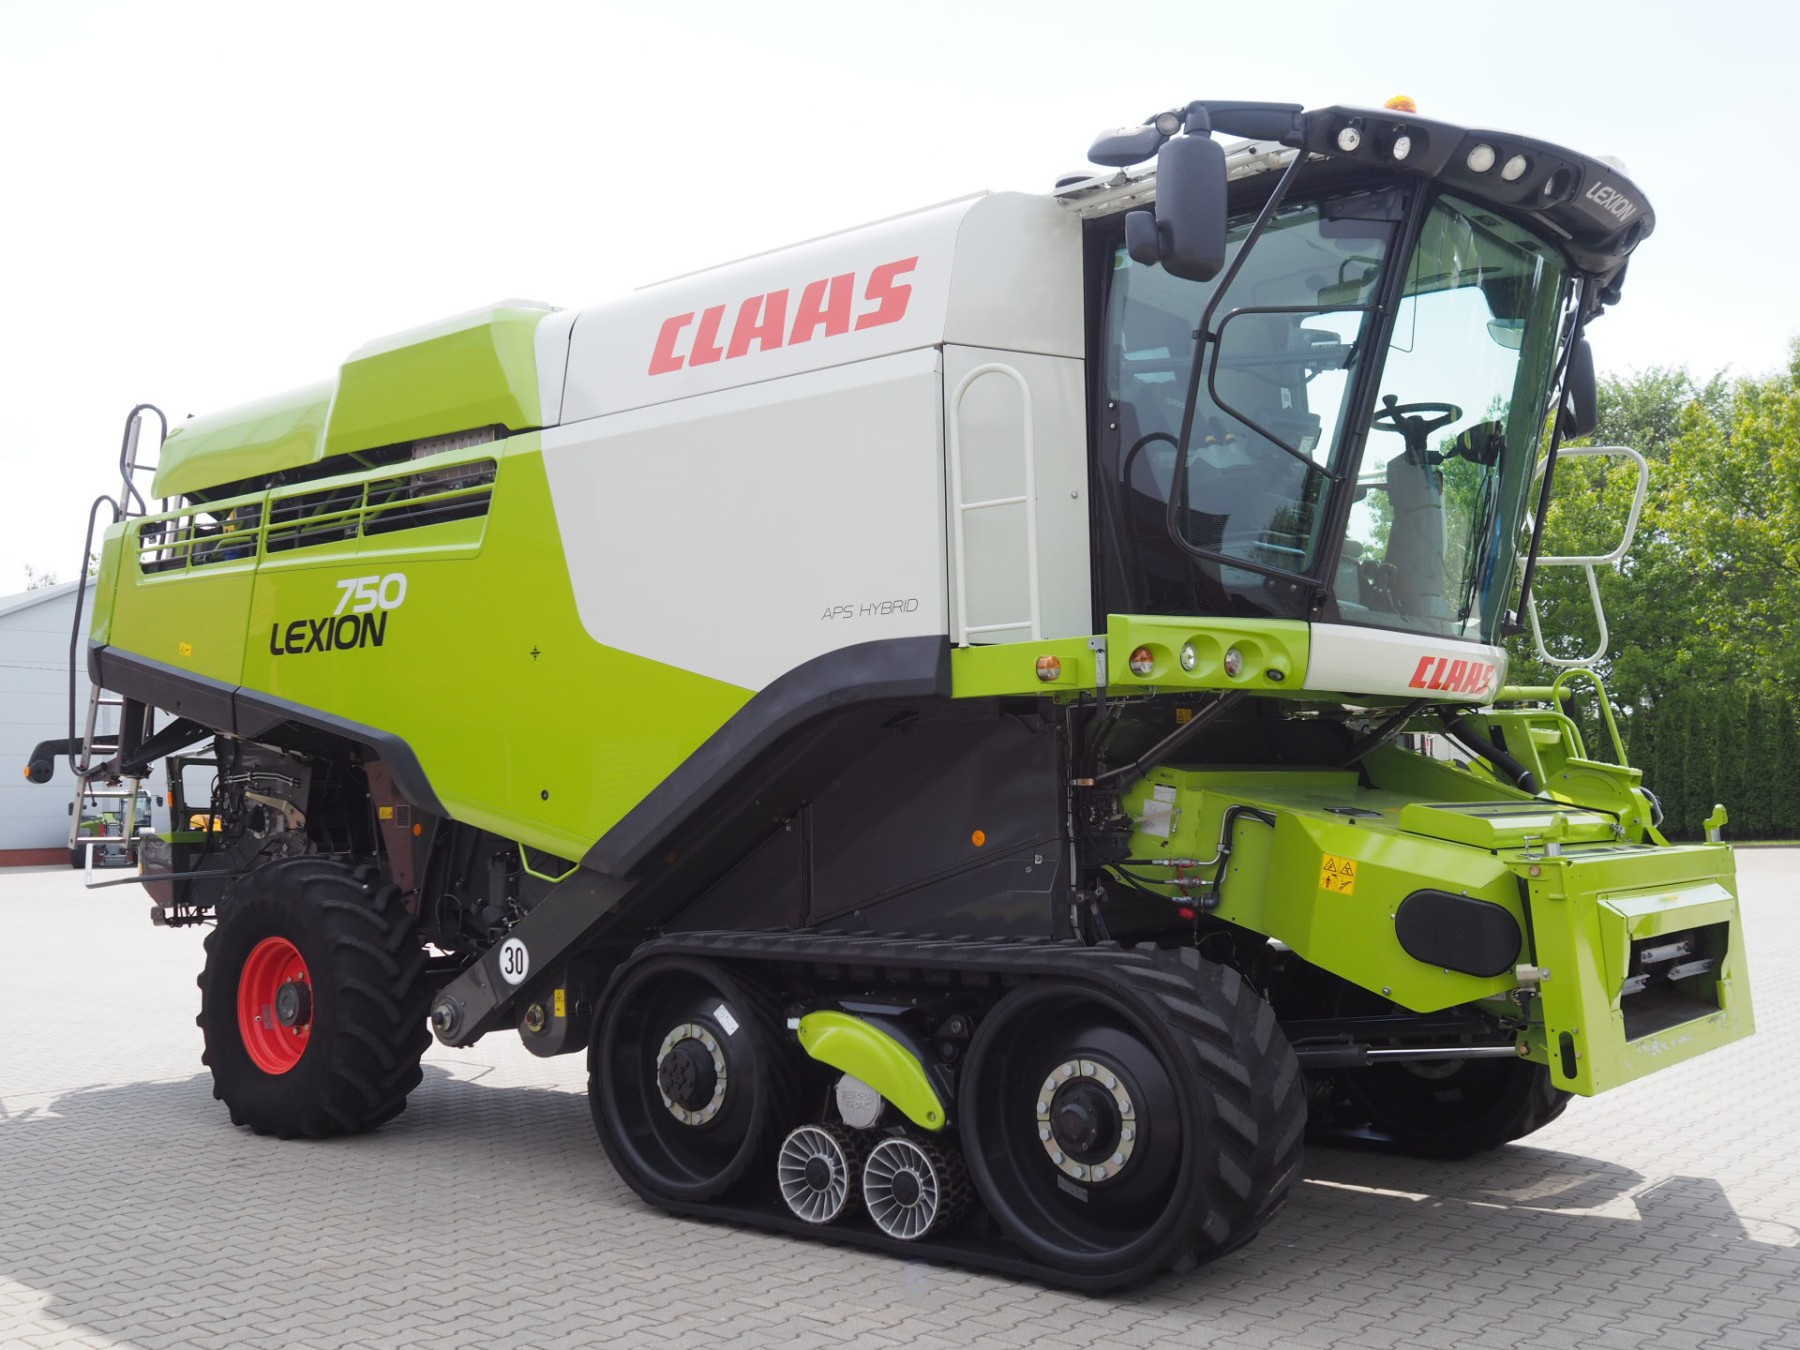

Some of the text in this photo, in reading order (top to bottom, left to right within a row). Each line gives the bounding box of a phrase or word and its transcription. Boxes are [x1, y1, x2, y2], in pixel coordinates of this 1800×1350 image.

[1585, 181, 1637, 222] LEXION
[648, 256, 919, 376] CLAAS
[333, 572, 407, 615] 750
[821, 598, 919, 620] APS HYBRID
[270, 611, 387, 655] LEXION
[1408, 655, 1494, 694] CLAAS
[504, 946, 523, 975] 30
